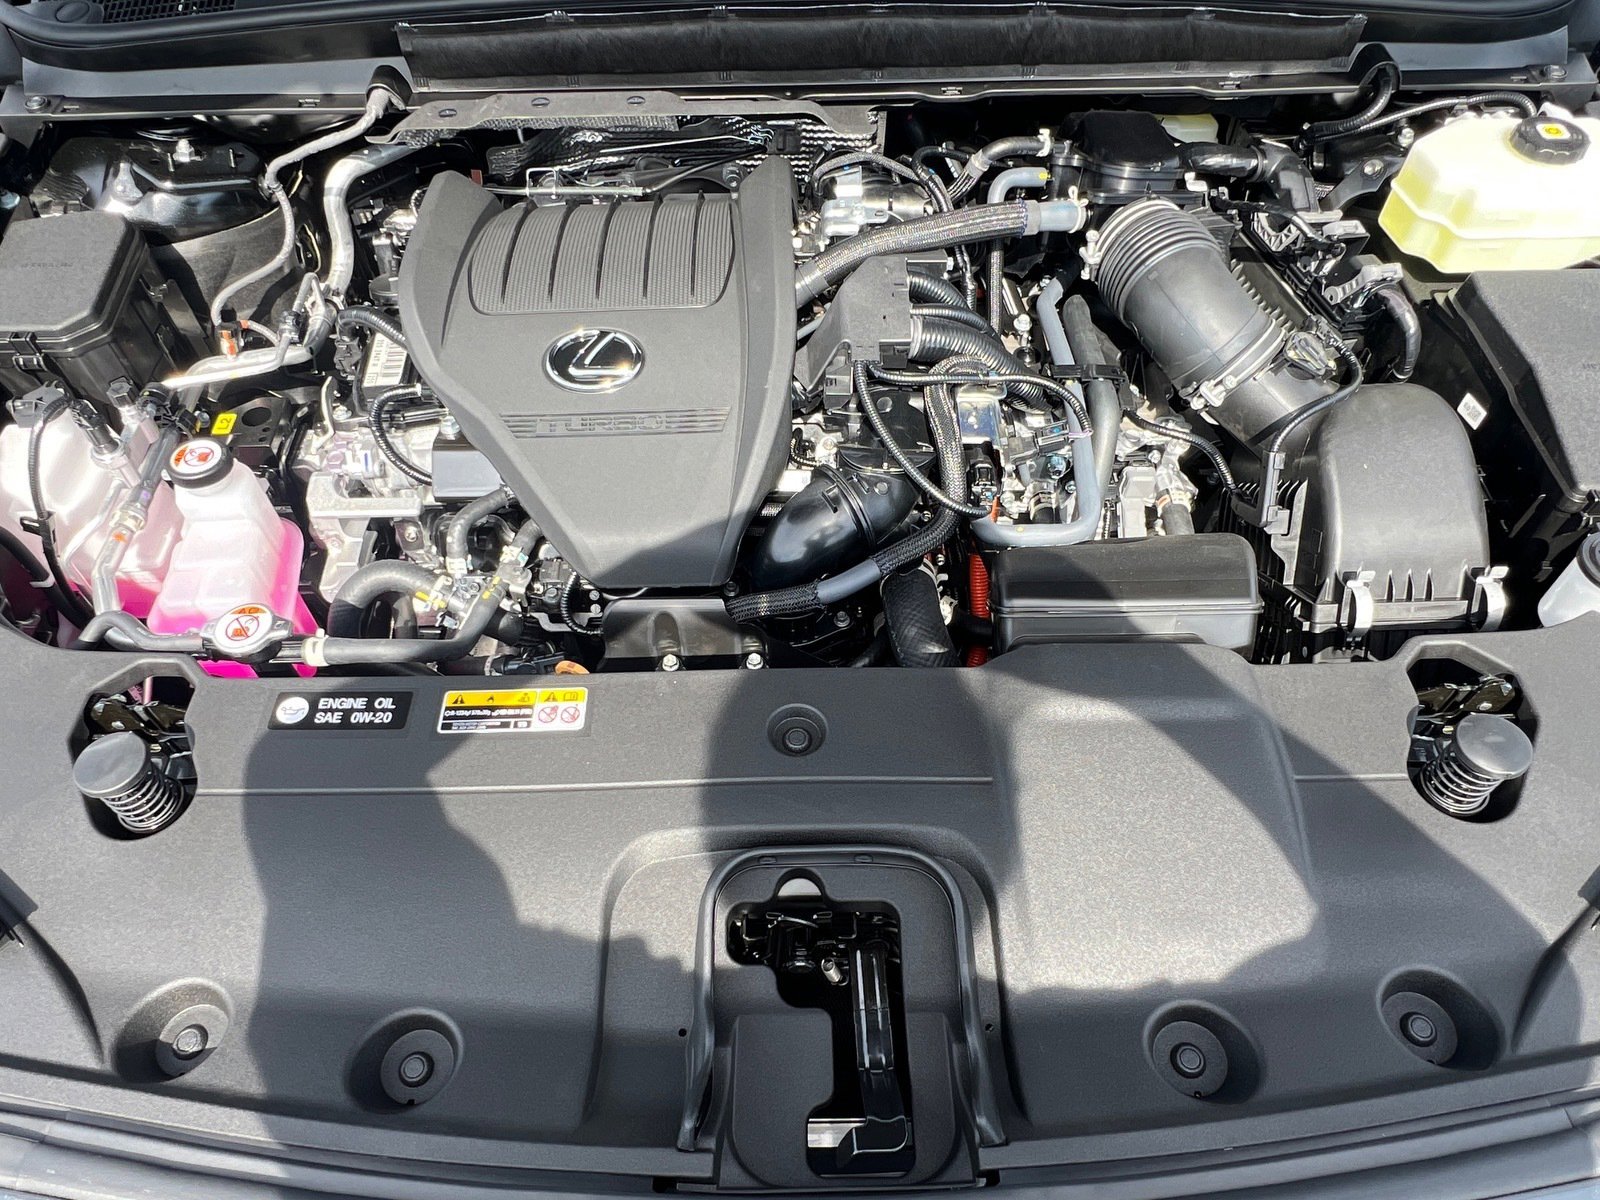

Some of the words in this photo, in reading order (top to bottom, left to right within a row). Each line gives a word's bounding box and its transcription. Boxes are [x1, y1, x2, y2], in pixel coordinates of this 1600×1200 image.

[216, 417, 232, 430] L2
[539, 414, 664, 433] TURBO
[318, 697, 369, 709] ENGINE
[374, 697, 396, 709] OIL
[314, 711, 344, 724] SAE
[350, 711, 393, 724] 0W-20
